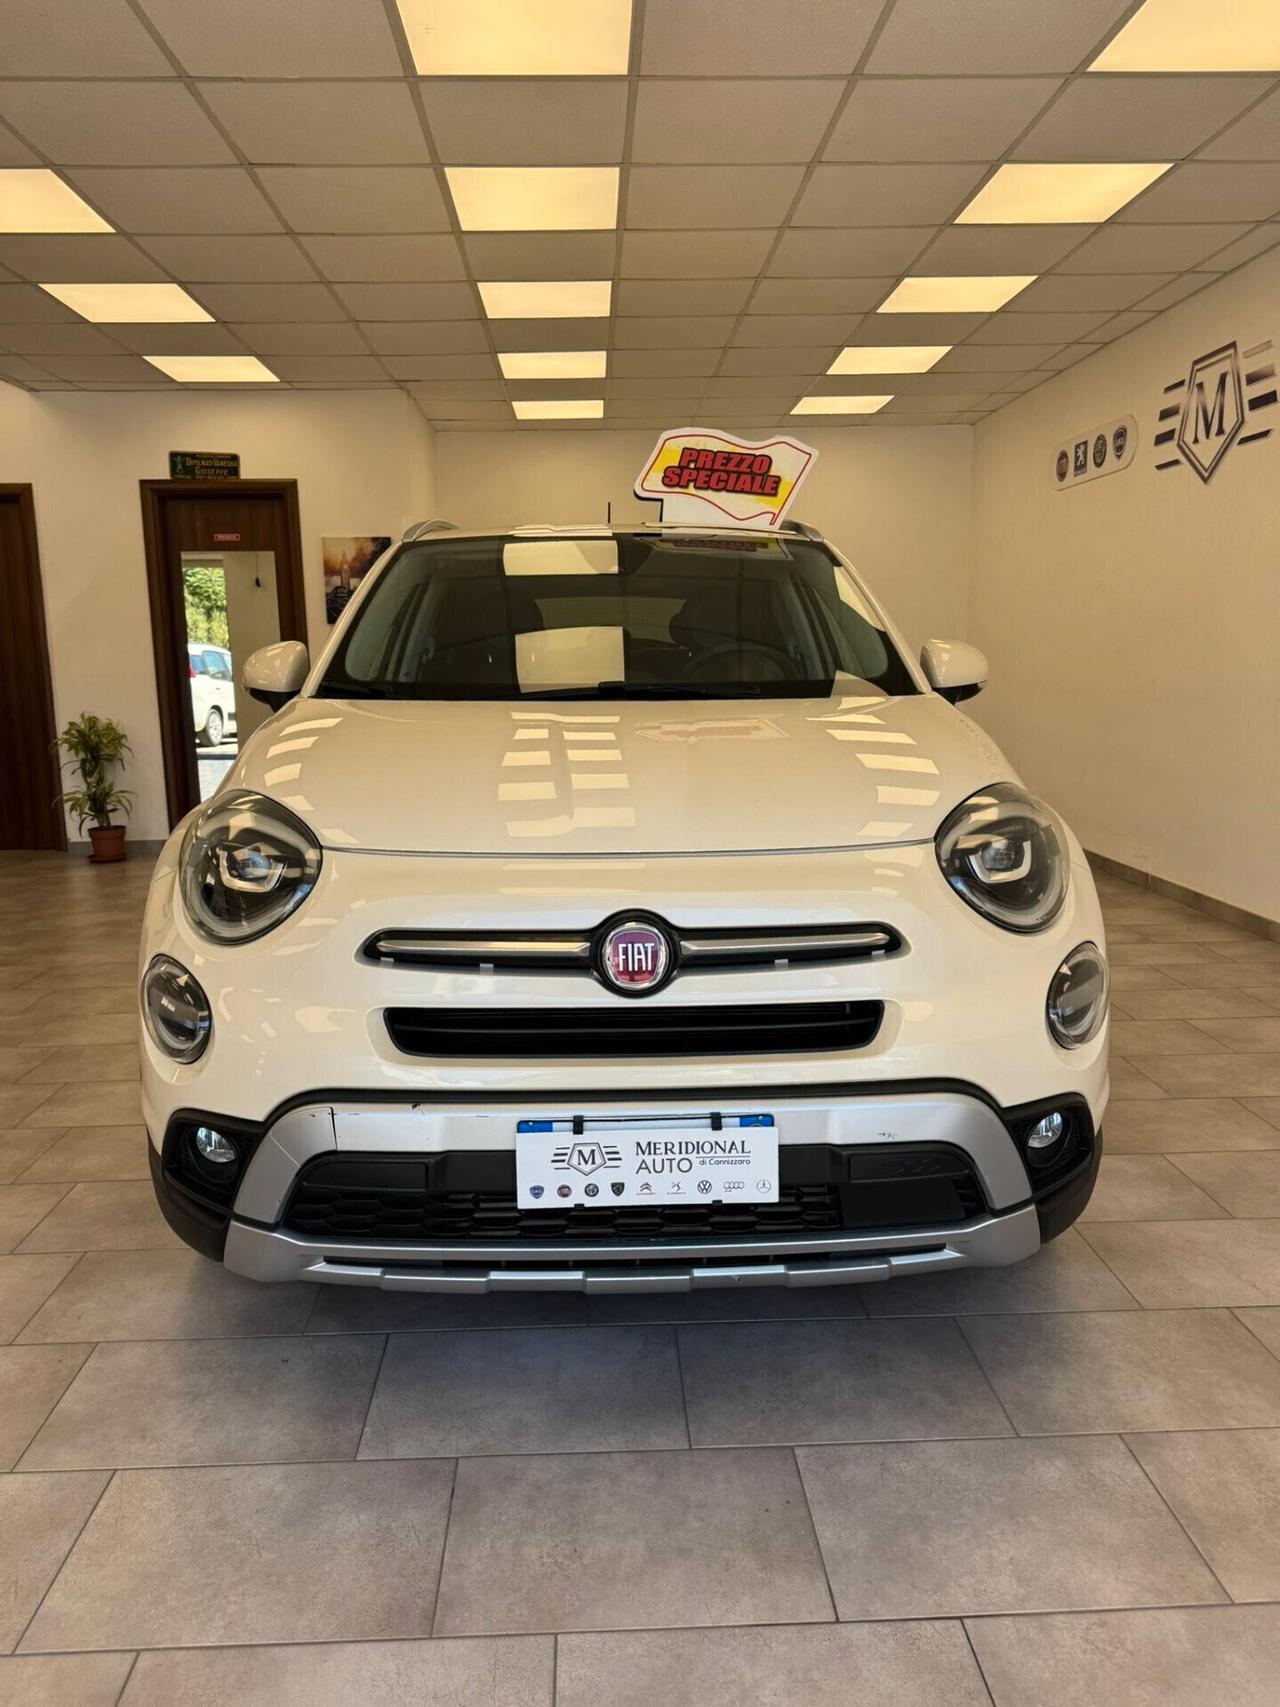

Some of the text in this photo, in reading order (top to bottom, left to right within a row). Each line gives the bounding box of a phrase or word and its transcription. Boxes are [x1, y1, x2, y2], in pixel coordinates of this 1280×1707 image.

[1192, 371, 1229, 445] M
[679, 447, 772, 475] PREZZO
[662, 466, 781, 497] SPECIALE
[618, 943, 654, 971] FIAT
[577, 1149, 596, 1166] M
[635, 1140, 751, 1156] MERIDIONAL
[635, 1157, 693, 1174] AUTO
[699, 1157, 751, 1166] di Cannizzaro
